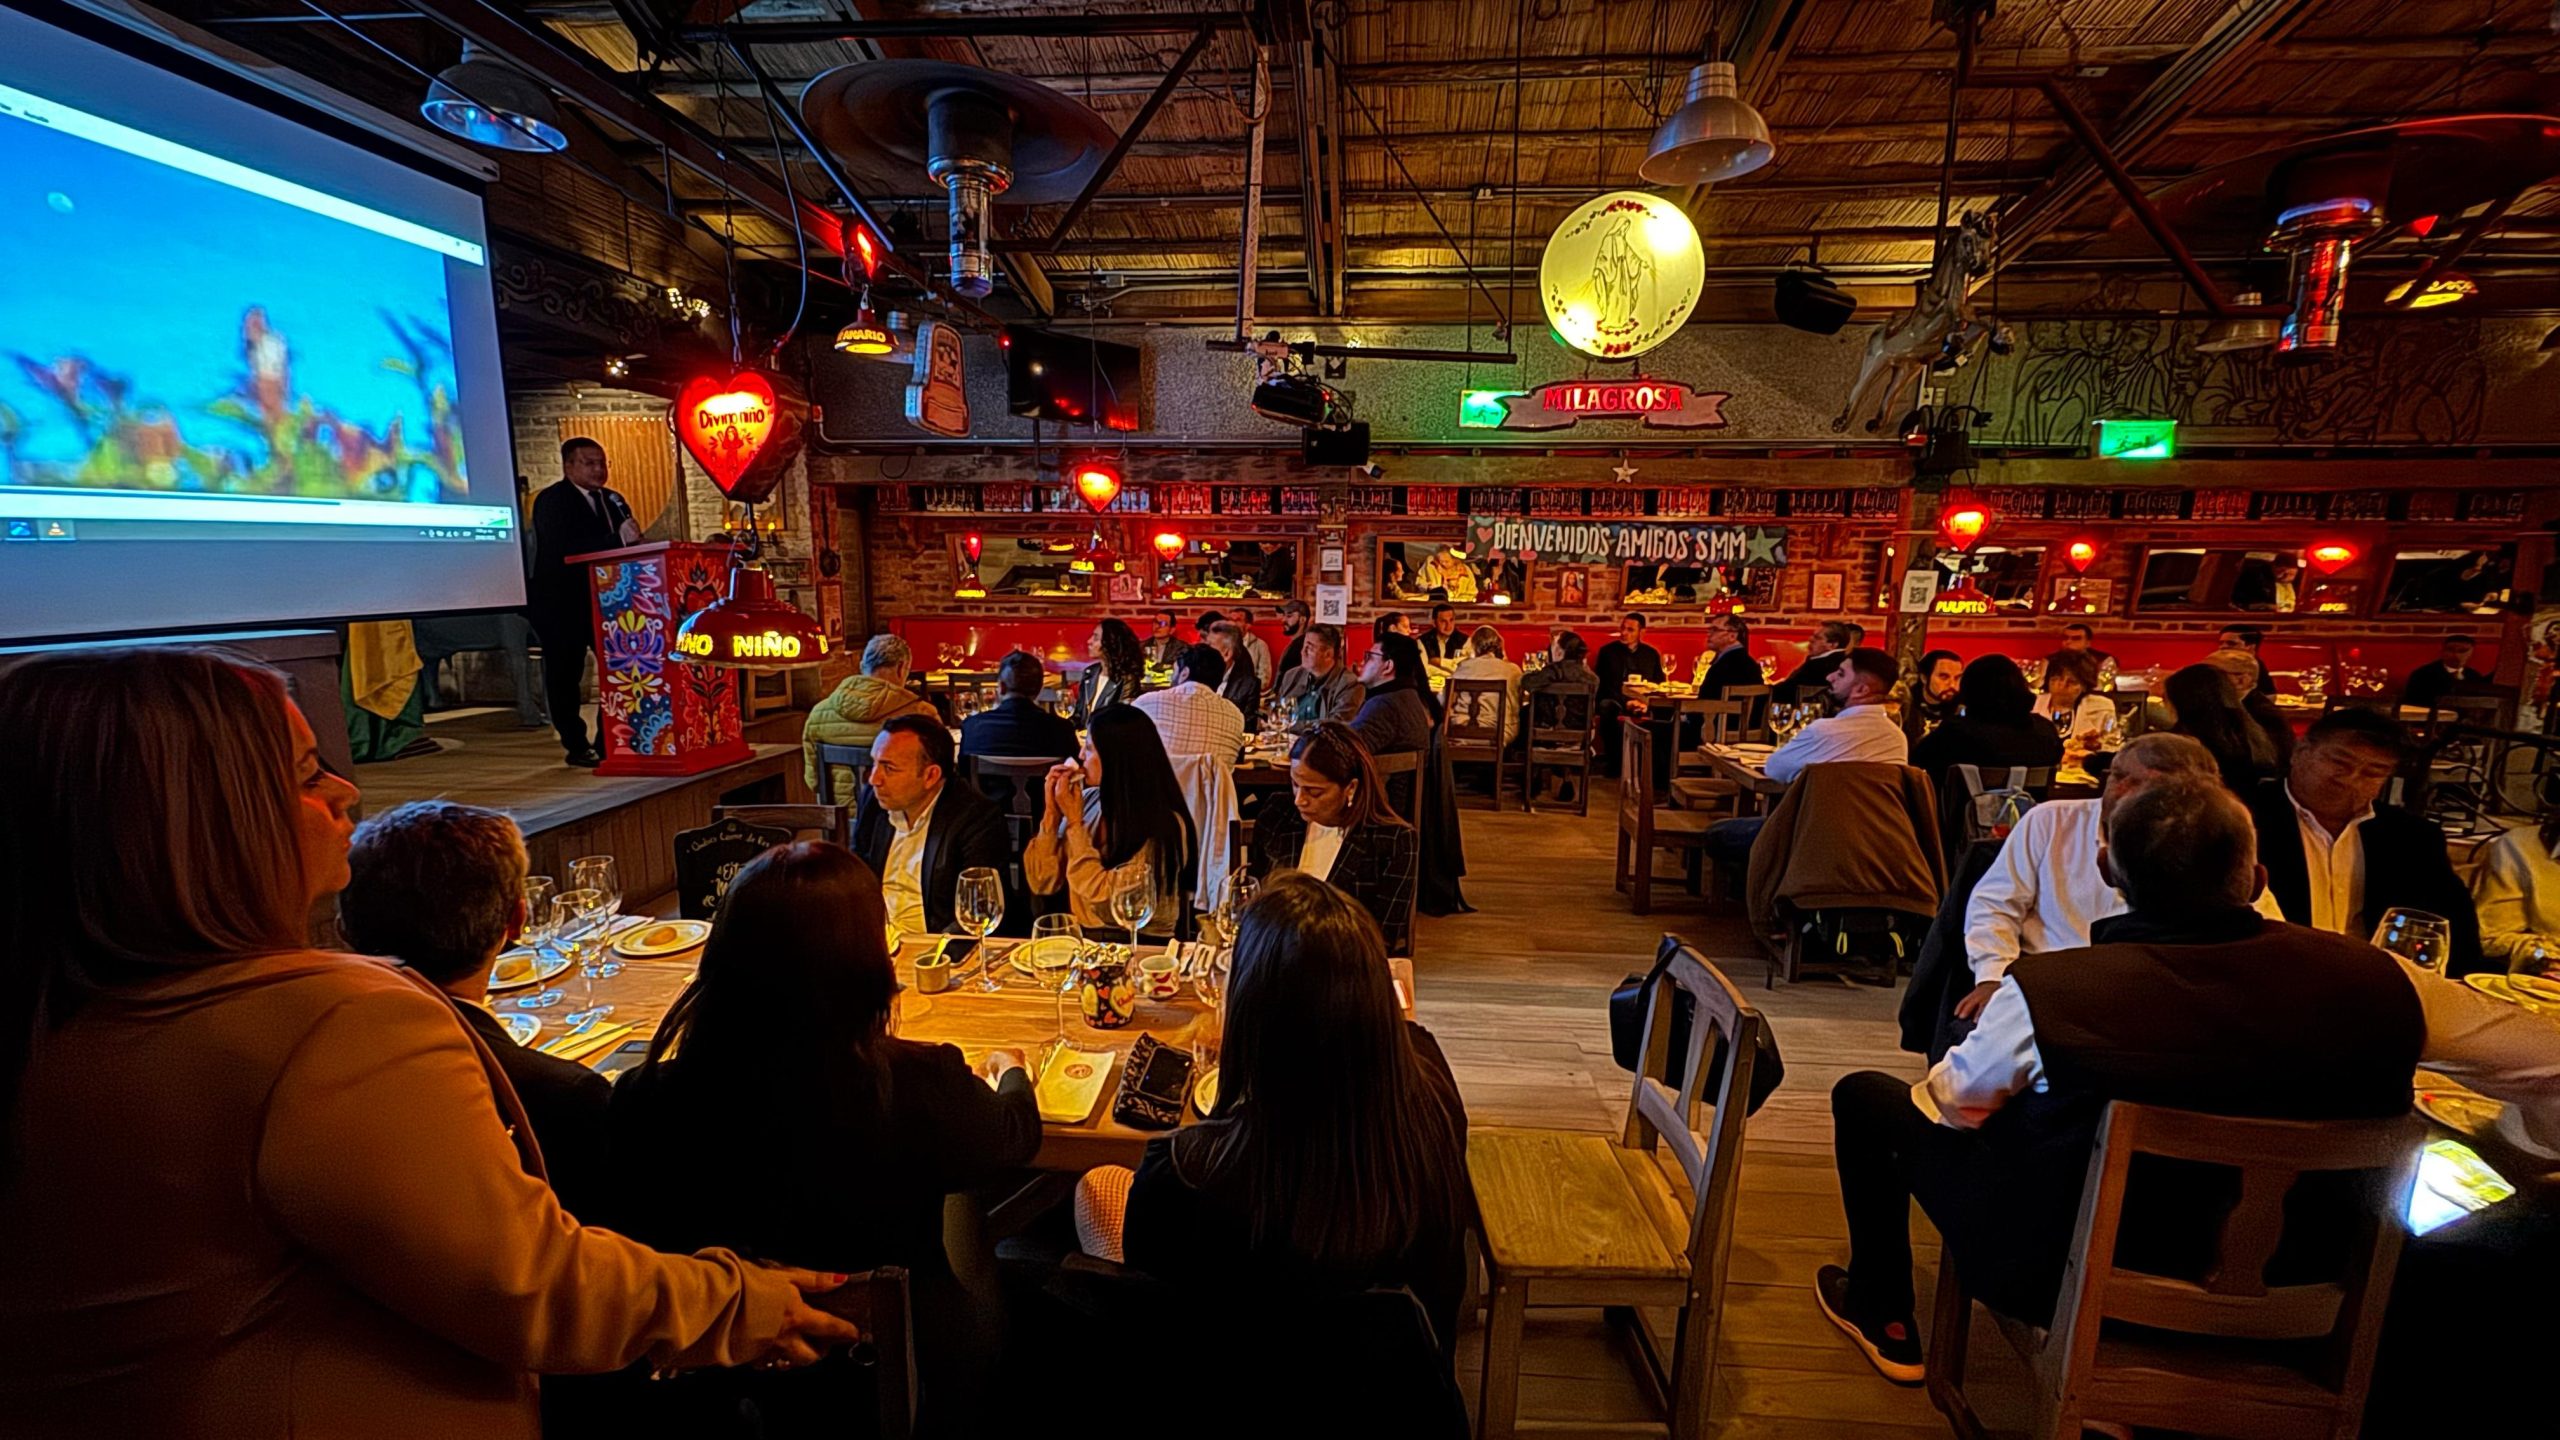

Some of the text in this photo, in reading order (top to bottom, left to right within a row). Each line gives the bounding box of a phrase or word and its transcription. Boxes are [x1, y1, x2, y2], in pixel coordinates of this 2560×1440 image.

[1543, 387, 1683, 411] MILAGROSA
[699, 406, 765, 429] Divino niño
[1494, 522, 1747, 562] BIENVENIDOS AMIGOS SMM
[1935, 601, 1988, 614] PULPITO
[733, 630, 801, 658] NIÑO
